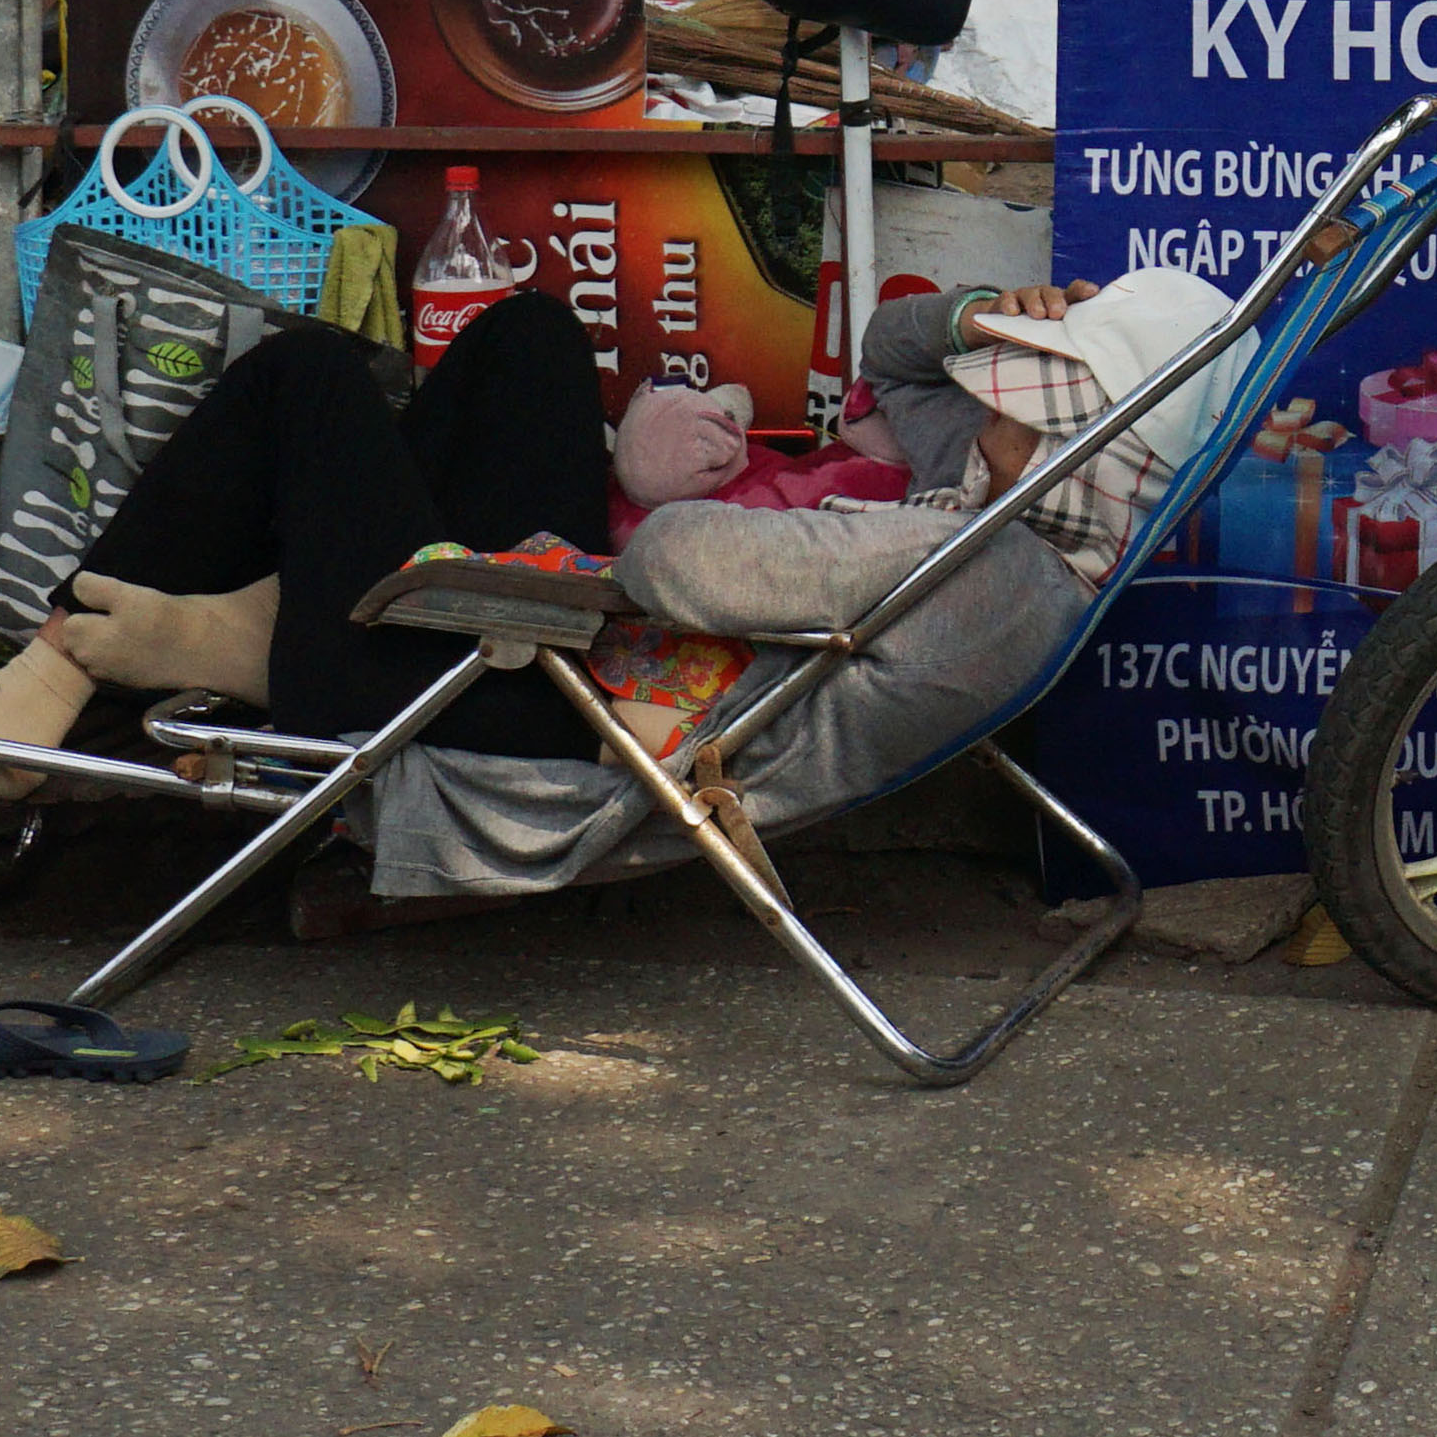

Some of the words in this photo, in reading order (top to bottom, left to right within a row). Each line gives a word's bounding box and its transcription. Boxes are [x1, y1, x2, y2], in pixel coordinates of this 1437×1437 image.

[1083, 141, 1203, 196] TƯNG
[1214, 140, 1334, 199] BỪNG
[652, 240, 697, 335] thu
[418, 302, 489, 333] Coca-Co
[1097, 642, 1191, 689] 137C
[1197, 789, 1253, 833] TP.
